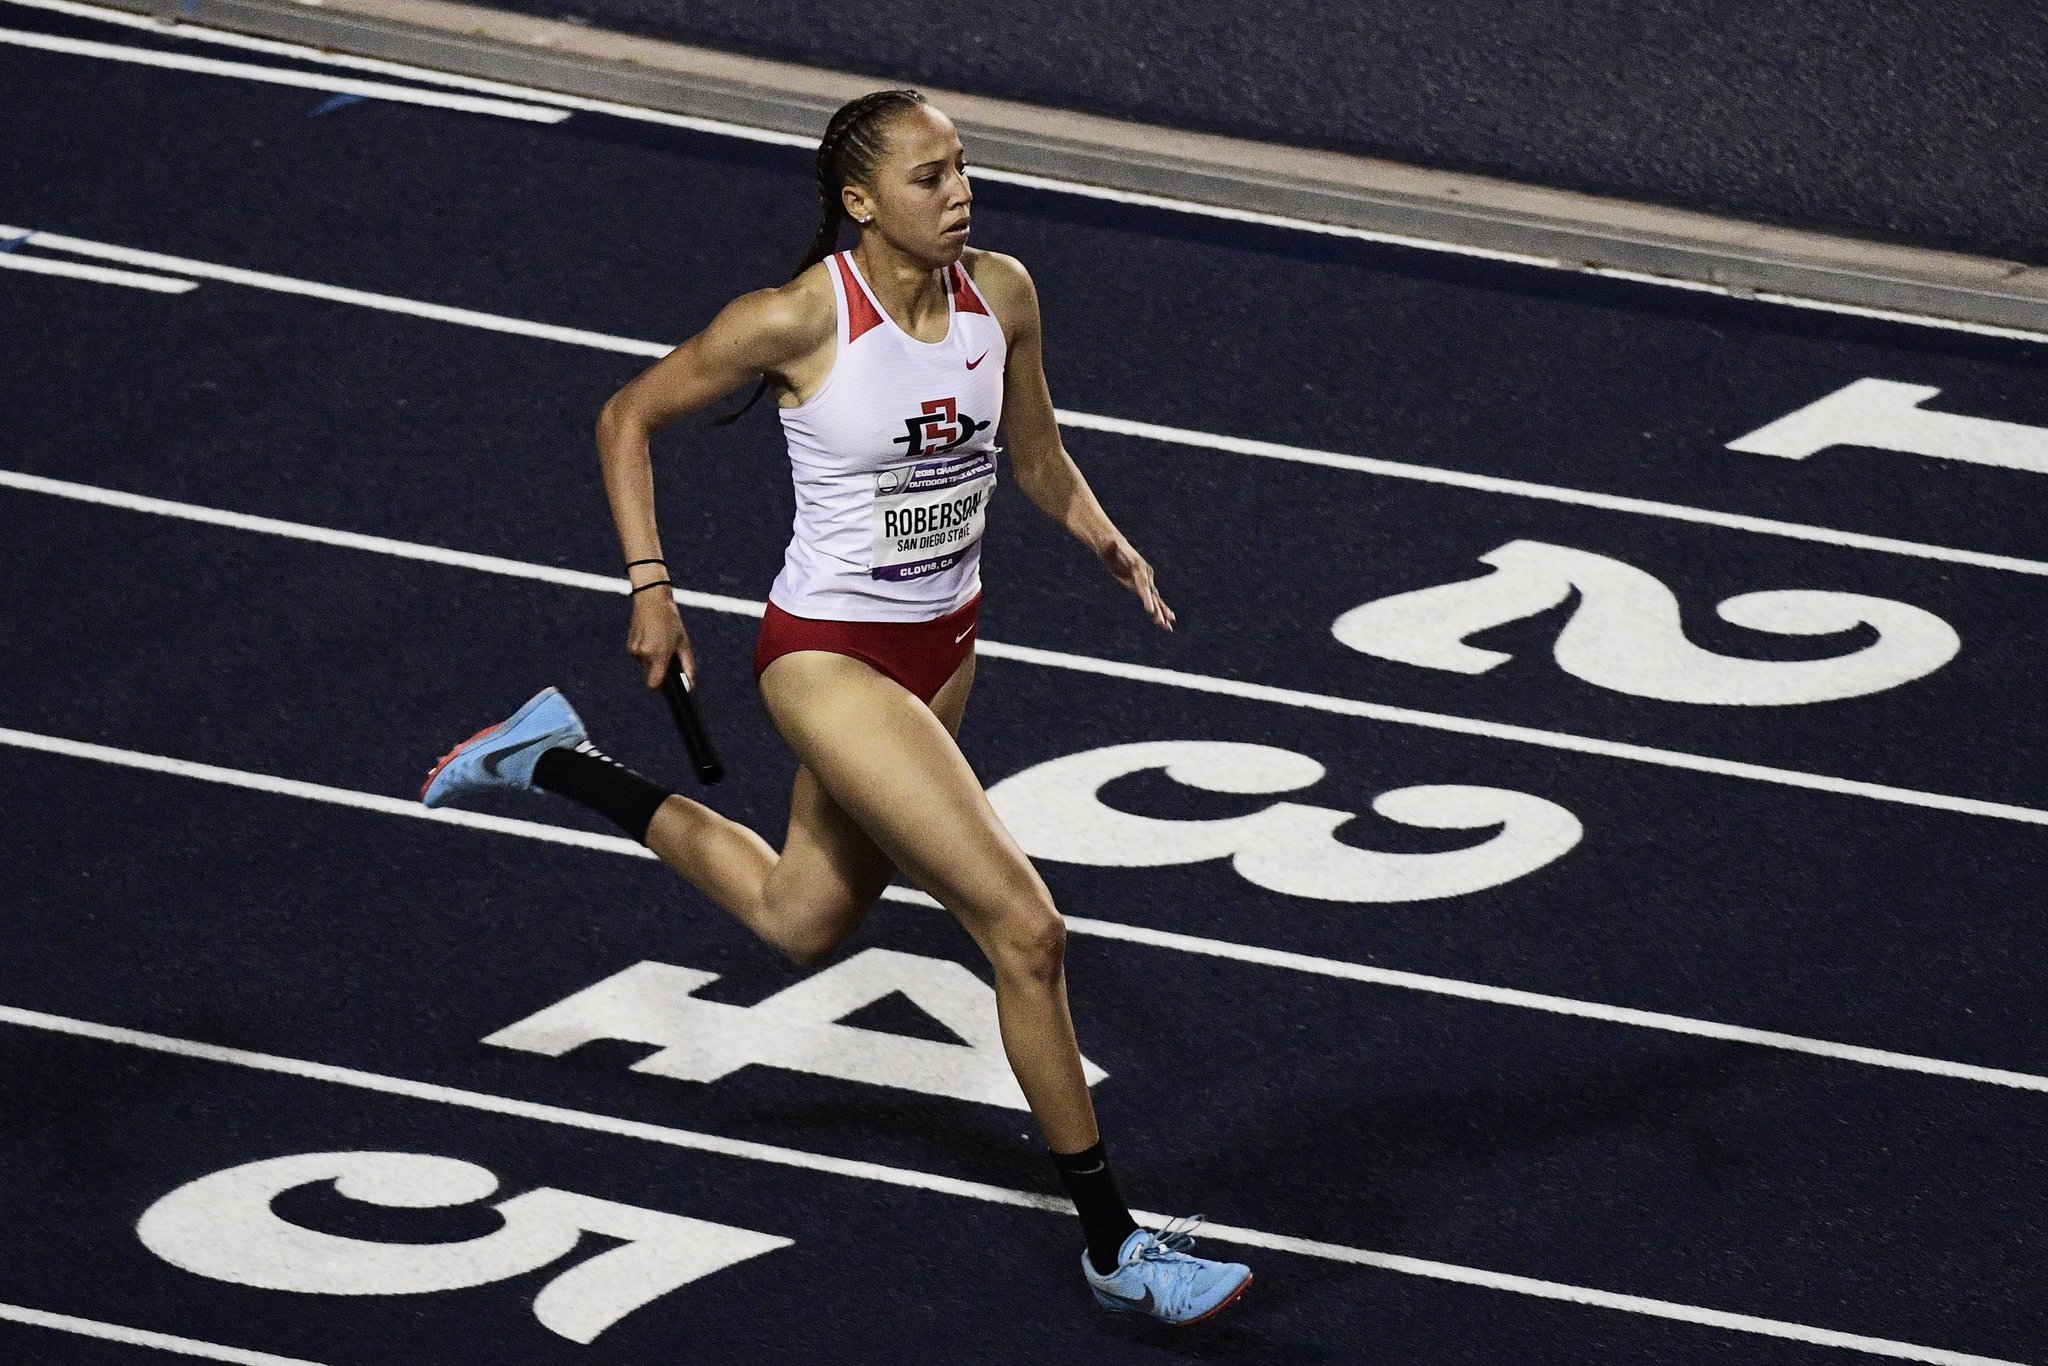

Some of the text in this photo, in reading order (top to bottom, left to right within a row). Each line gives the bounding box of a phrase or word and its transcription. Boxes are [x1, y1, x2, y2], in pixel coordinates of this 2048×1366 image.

[1725, 377, 2048, 473] 1
[884, 490, 982, 538] ROBERSON
[908, 478, 947, 489] OUTDOOR
[897, 523, 971, 552] SAN DIEGO STATE
[900, 558, 953, 577] CLOVIS, CA
[1331, 539, 1961, 706] 2
[985, 740, 1583, 902] 3
[480, 947, 1109, 1112] 4
[136, 1150, 794, 1345] 5
